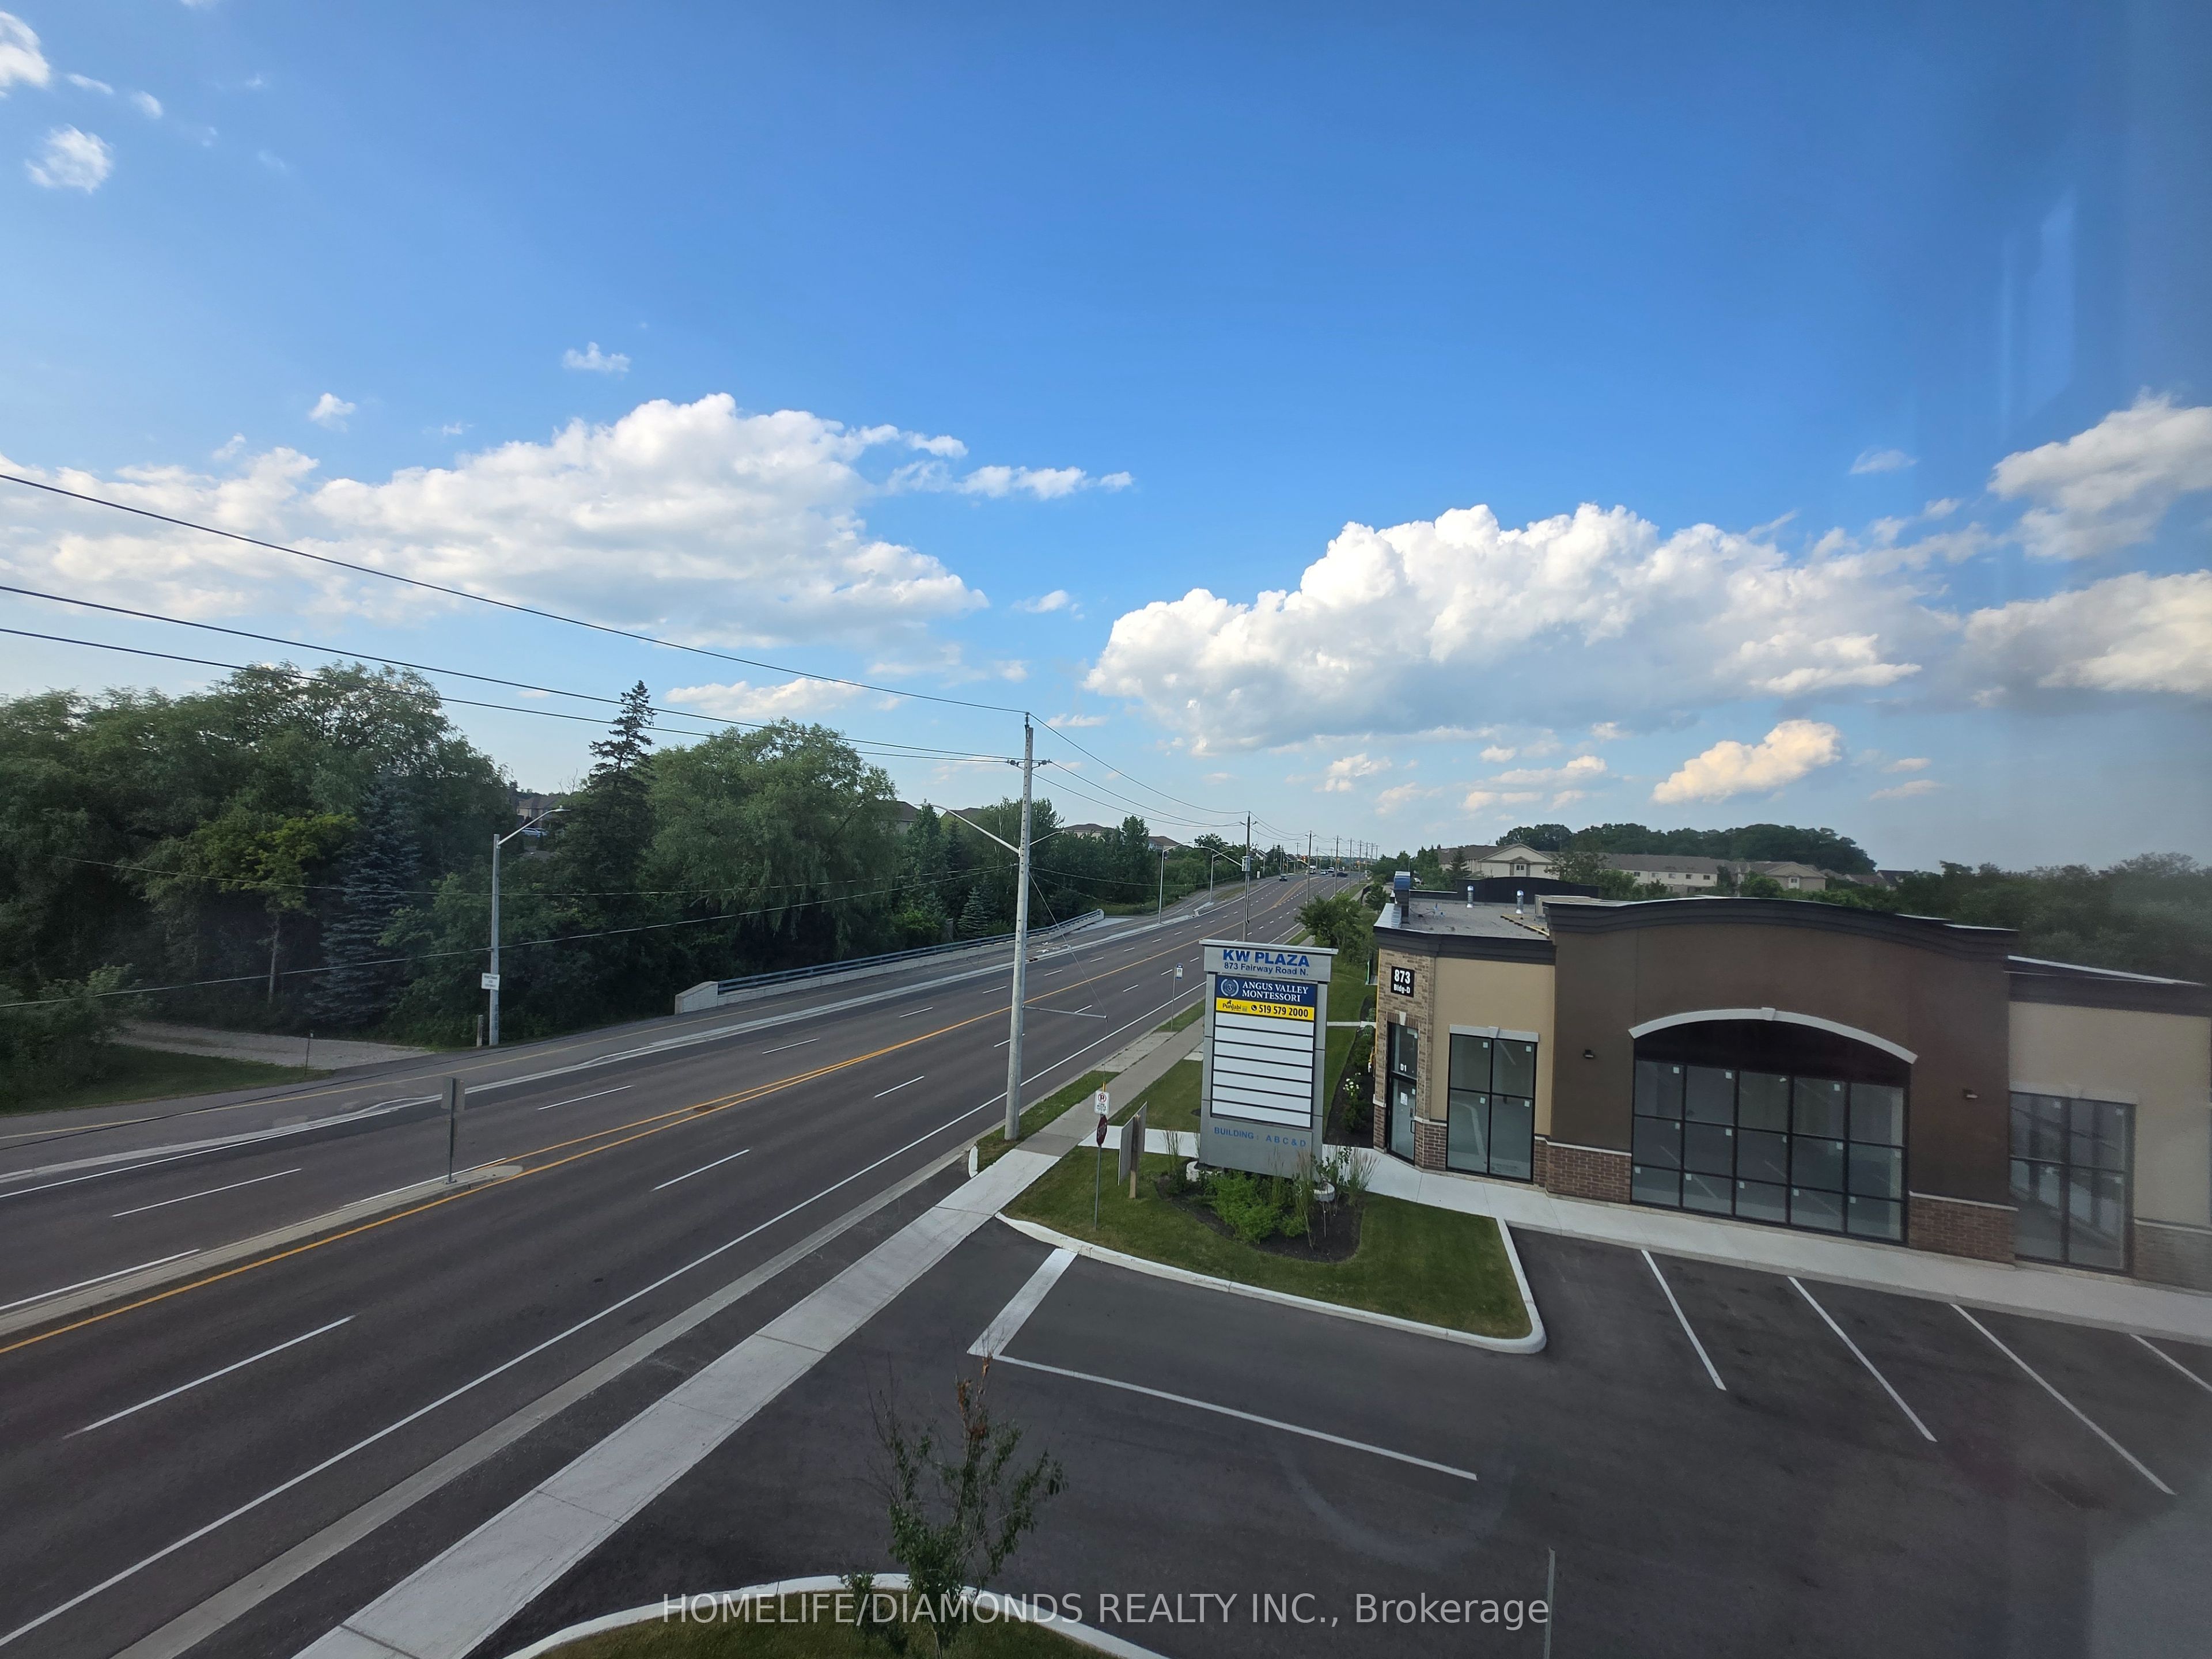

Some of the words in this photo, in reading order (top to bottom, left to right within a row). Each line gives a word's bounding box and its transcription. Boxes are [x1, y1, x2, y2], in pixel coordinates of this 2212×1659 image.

[1223, 949, 1250, 962] KW
[1255, 952, 1309, 967] PLAZA
[1241, 964, 1273, 974] Fairway
[1275, 967, 1296, 975] Road
[1394, 969, 1411, 984] 873
[1243, 982, 1272, 991] ANGUS
[1274, 984, 1309, 994] VALLEY
[1394, 983, 1410, 994] Bldg-D
[1242, 990, 1301, 1002] MONTESSORI
[1259, 1005, 1271, 1014] 519
[1274, 1006, 1286, 1015] 579
[1289, 1008, 1308, 1017] 2000
[1400, 1063, 1407, 1072] D1
[1214, 1127, 1254, 1139] BUILDING
